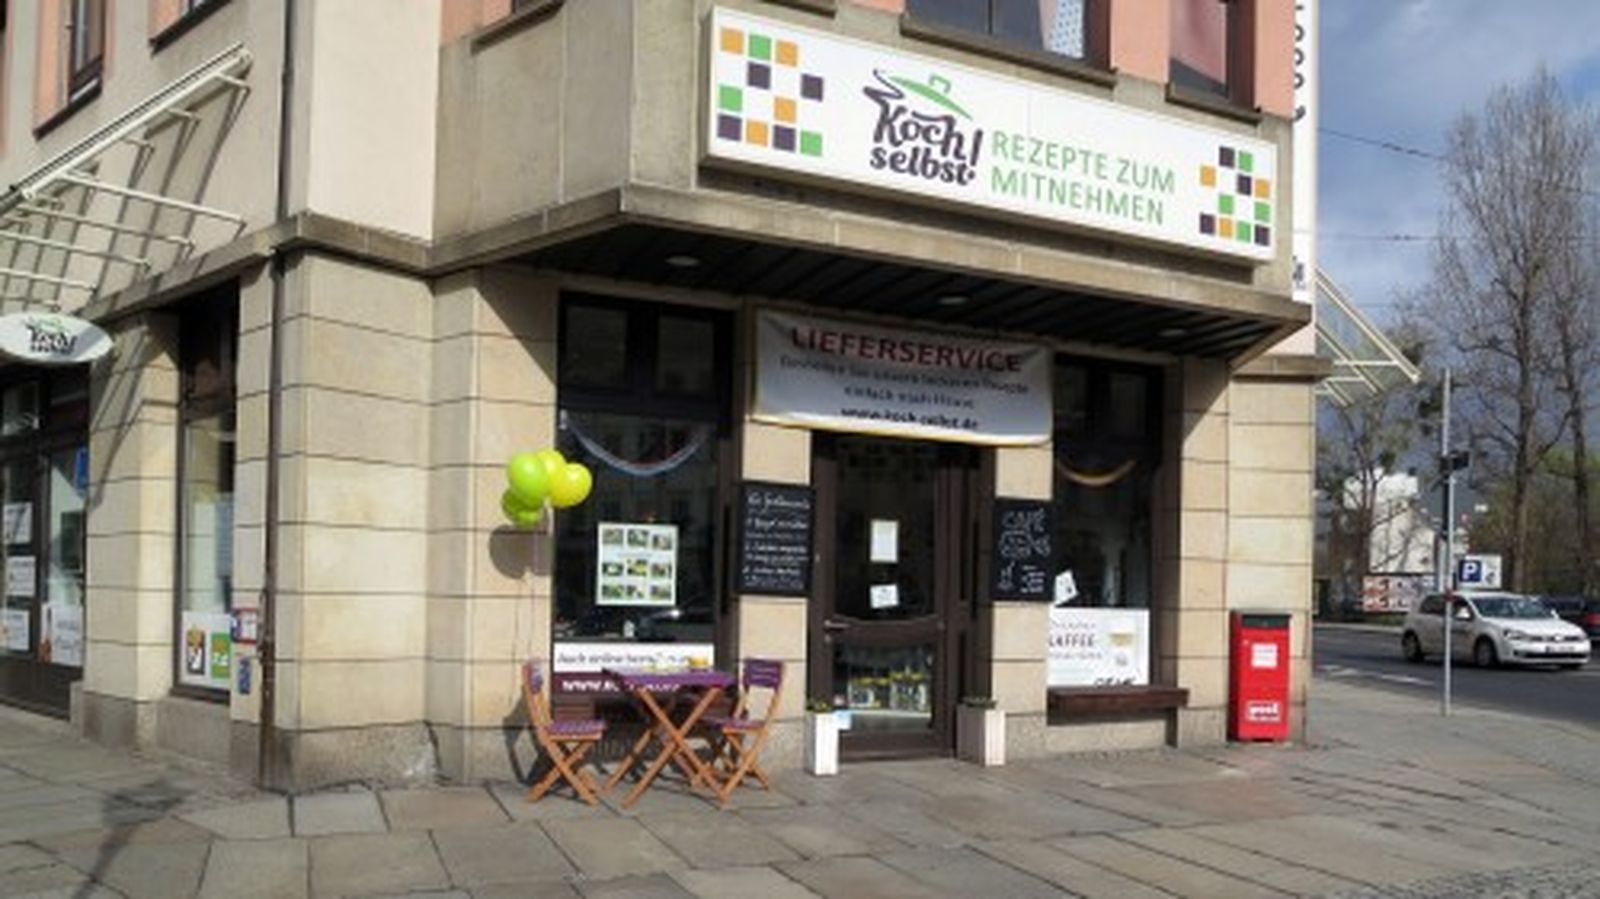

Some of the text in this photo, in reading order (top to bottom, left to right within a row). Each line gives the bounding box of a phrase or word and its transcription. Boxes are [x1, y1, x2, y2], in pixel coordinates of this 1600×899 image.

[869, 146, 969, 186] selbst
[991, 129, 1175, 195] REZEPTE ZUM
[990, 165, 1164, 226] MITNEHMEN
[790, 326, 1023, 374] LIEFERSERVICE
[1462, 561, 1478, 580] P
